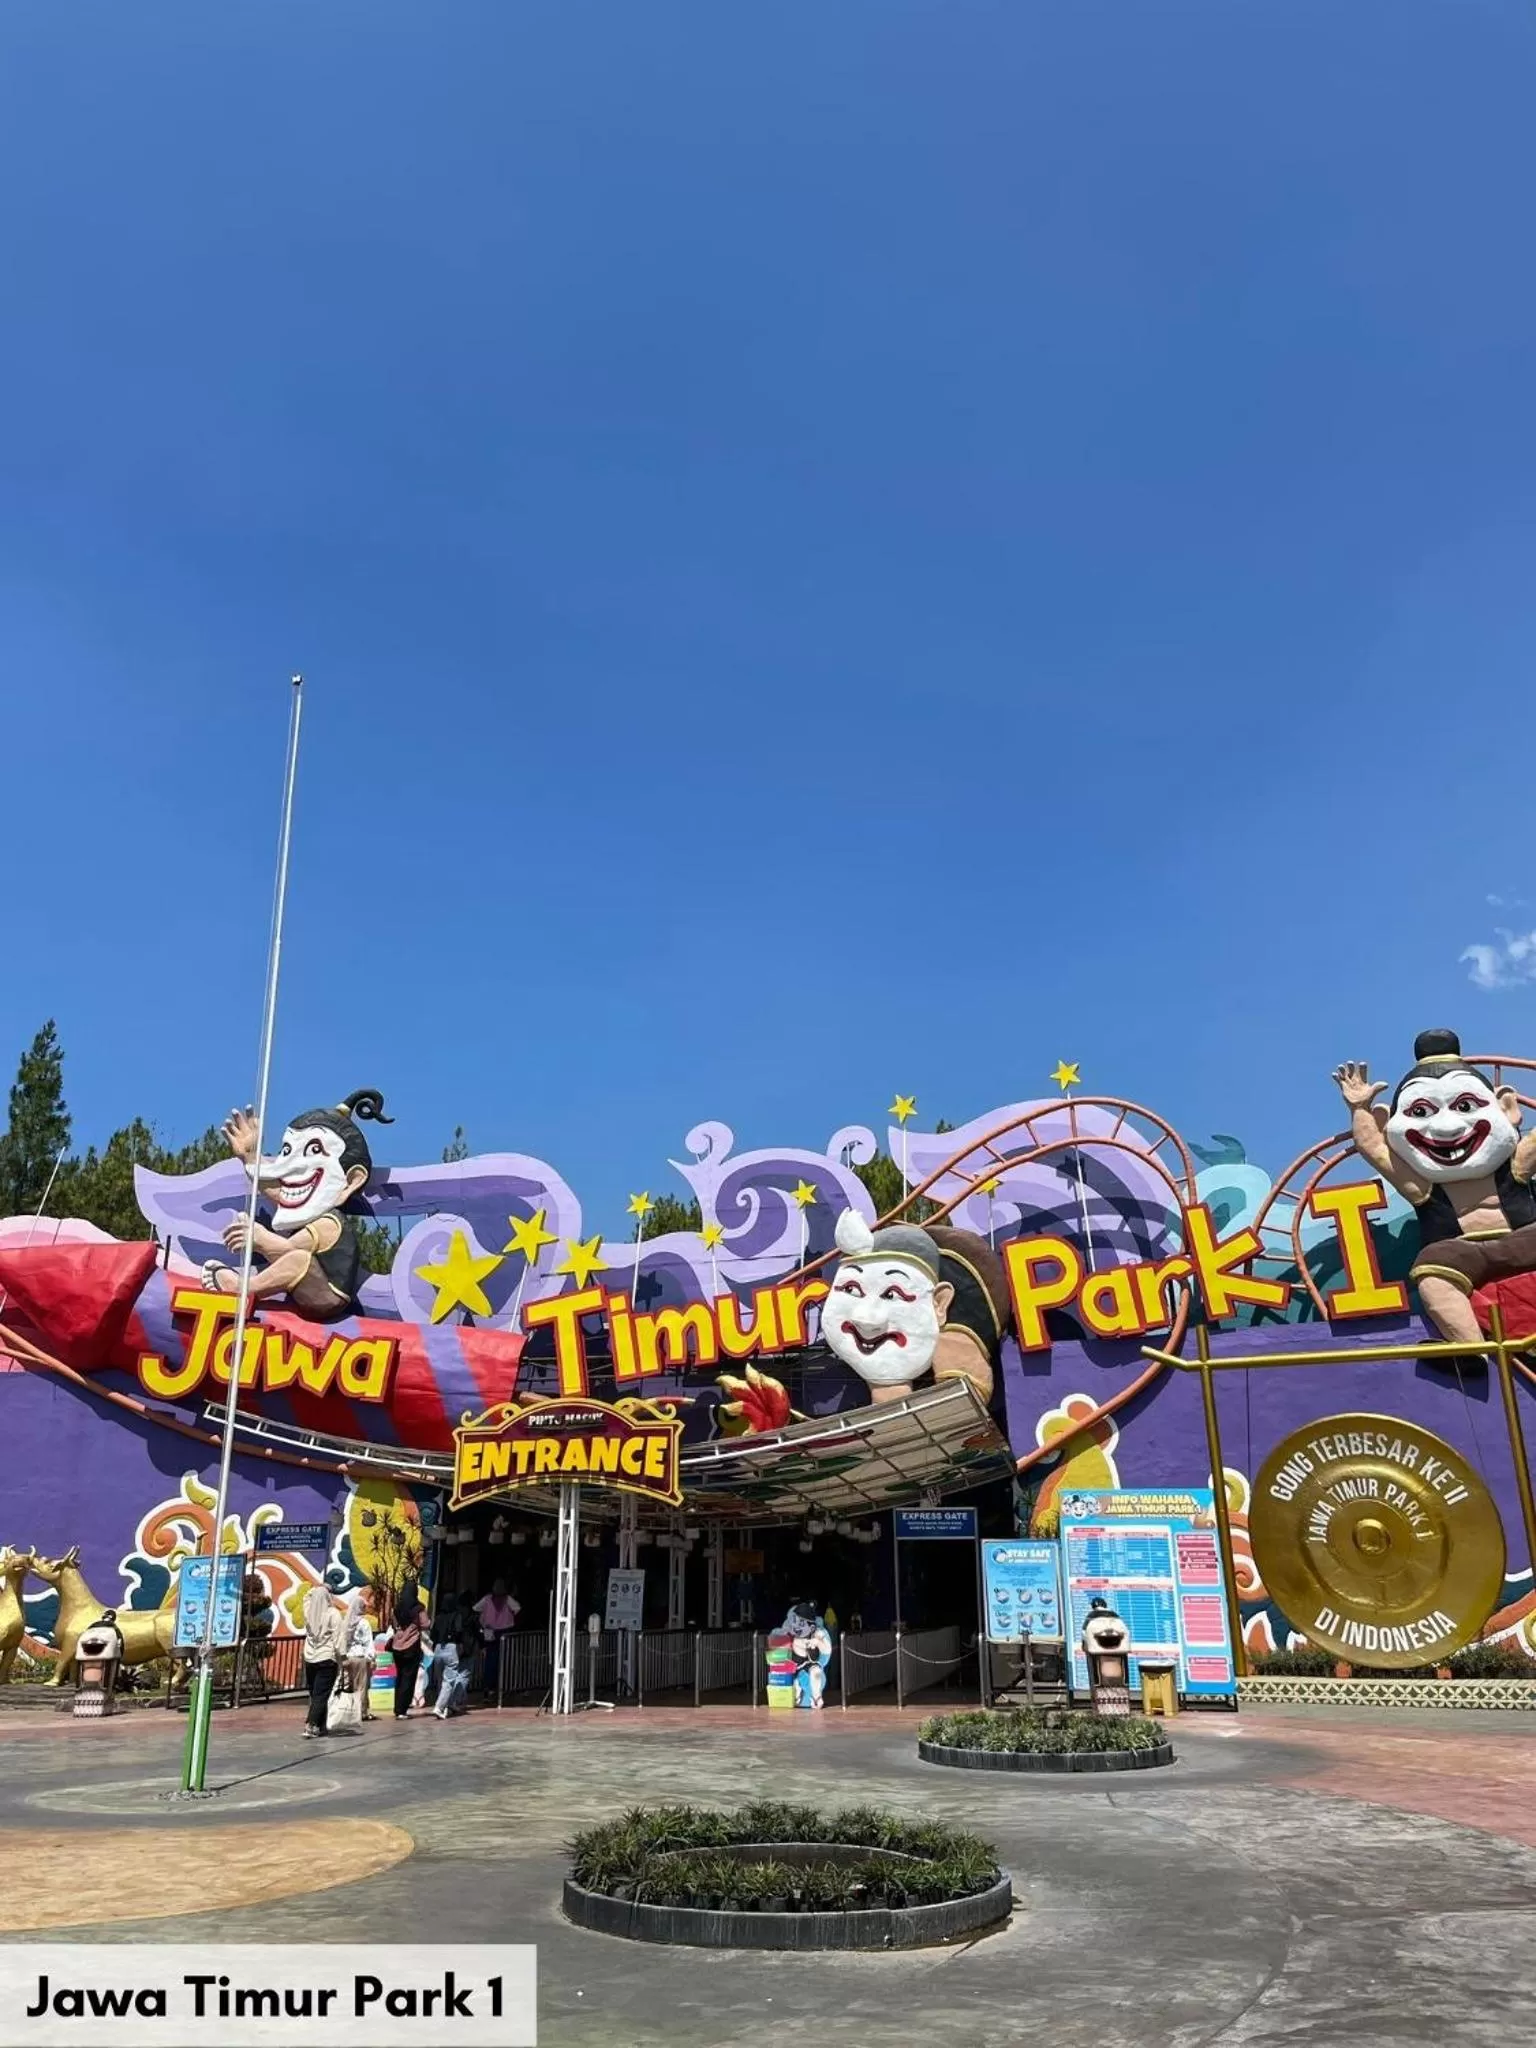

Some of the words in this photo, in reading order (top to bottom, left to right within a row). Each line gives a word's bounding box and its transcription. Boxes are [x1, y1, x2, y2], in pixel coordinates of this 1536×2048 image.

[138, 1287, 400, 1402] Jawa
[523, 1278, 832, 1398] Timur
[1004, 1204, 1290, 1353] Park
[461, 1435, 668, 1484] ENTRANCE
[1269, 1451, 1314, 1502] GONG
[1308, 1431, 1420, 1468] TERBESAR
[1418, 1455, 1453, 1491] KE
[1443, 1484, 1469, 1506] II
[902, 1512, 942, 1520] EXPRESS
[944, 1512, 968, 1520] GATE
[1105, 1504, 1133, 1514] JAWA
[1134, 1503, 1168, 1514] TIMUR
[1168, 1503, 1195, 1513] PARK
[1111, 1494, 1138, 1504] INFO
[1308, 1499, 1336, 1543] JAWA
[1327, 1478, 1379, 1504] TIMUR
[1384, 1483, 1429, 1527] PARK
[265, 1526, 300, 1534] EXPRESS
[1313, 1606, 1341, 1636] DI
[1341, 1610, 1458, 1652] INDONESIA
